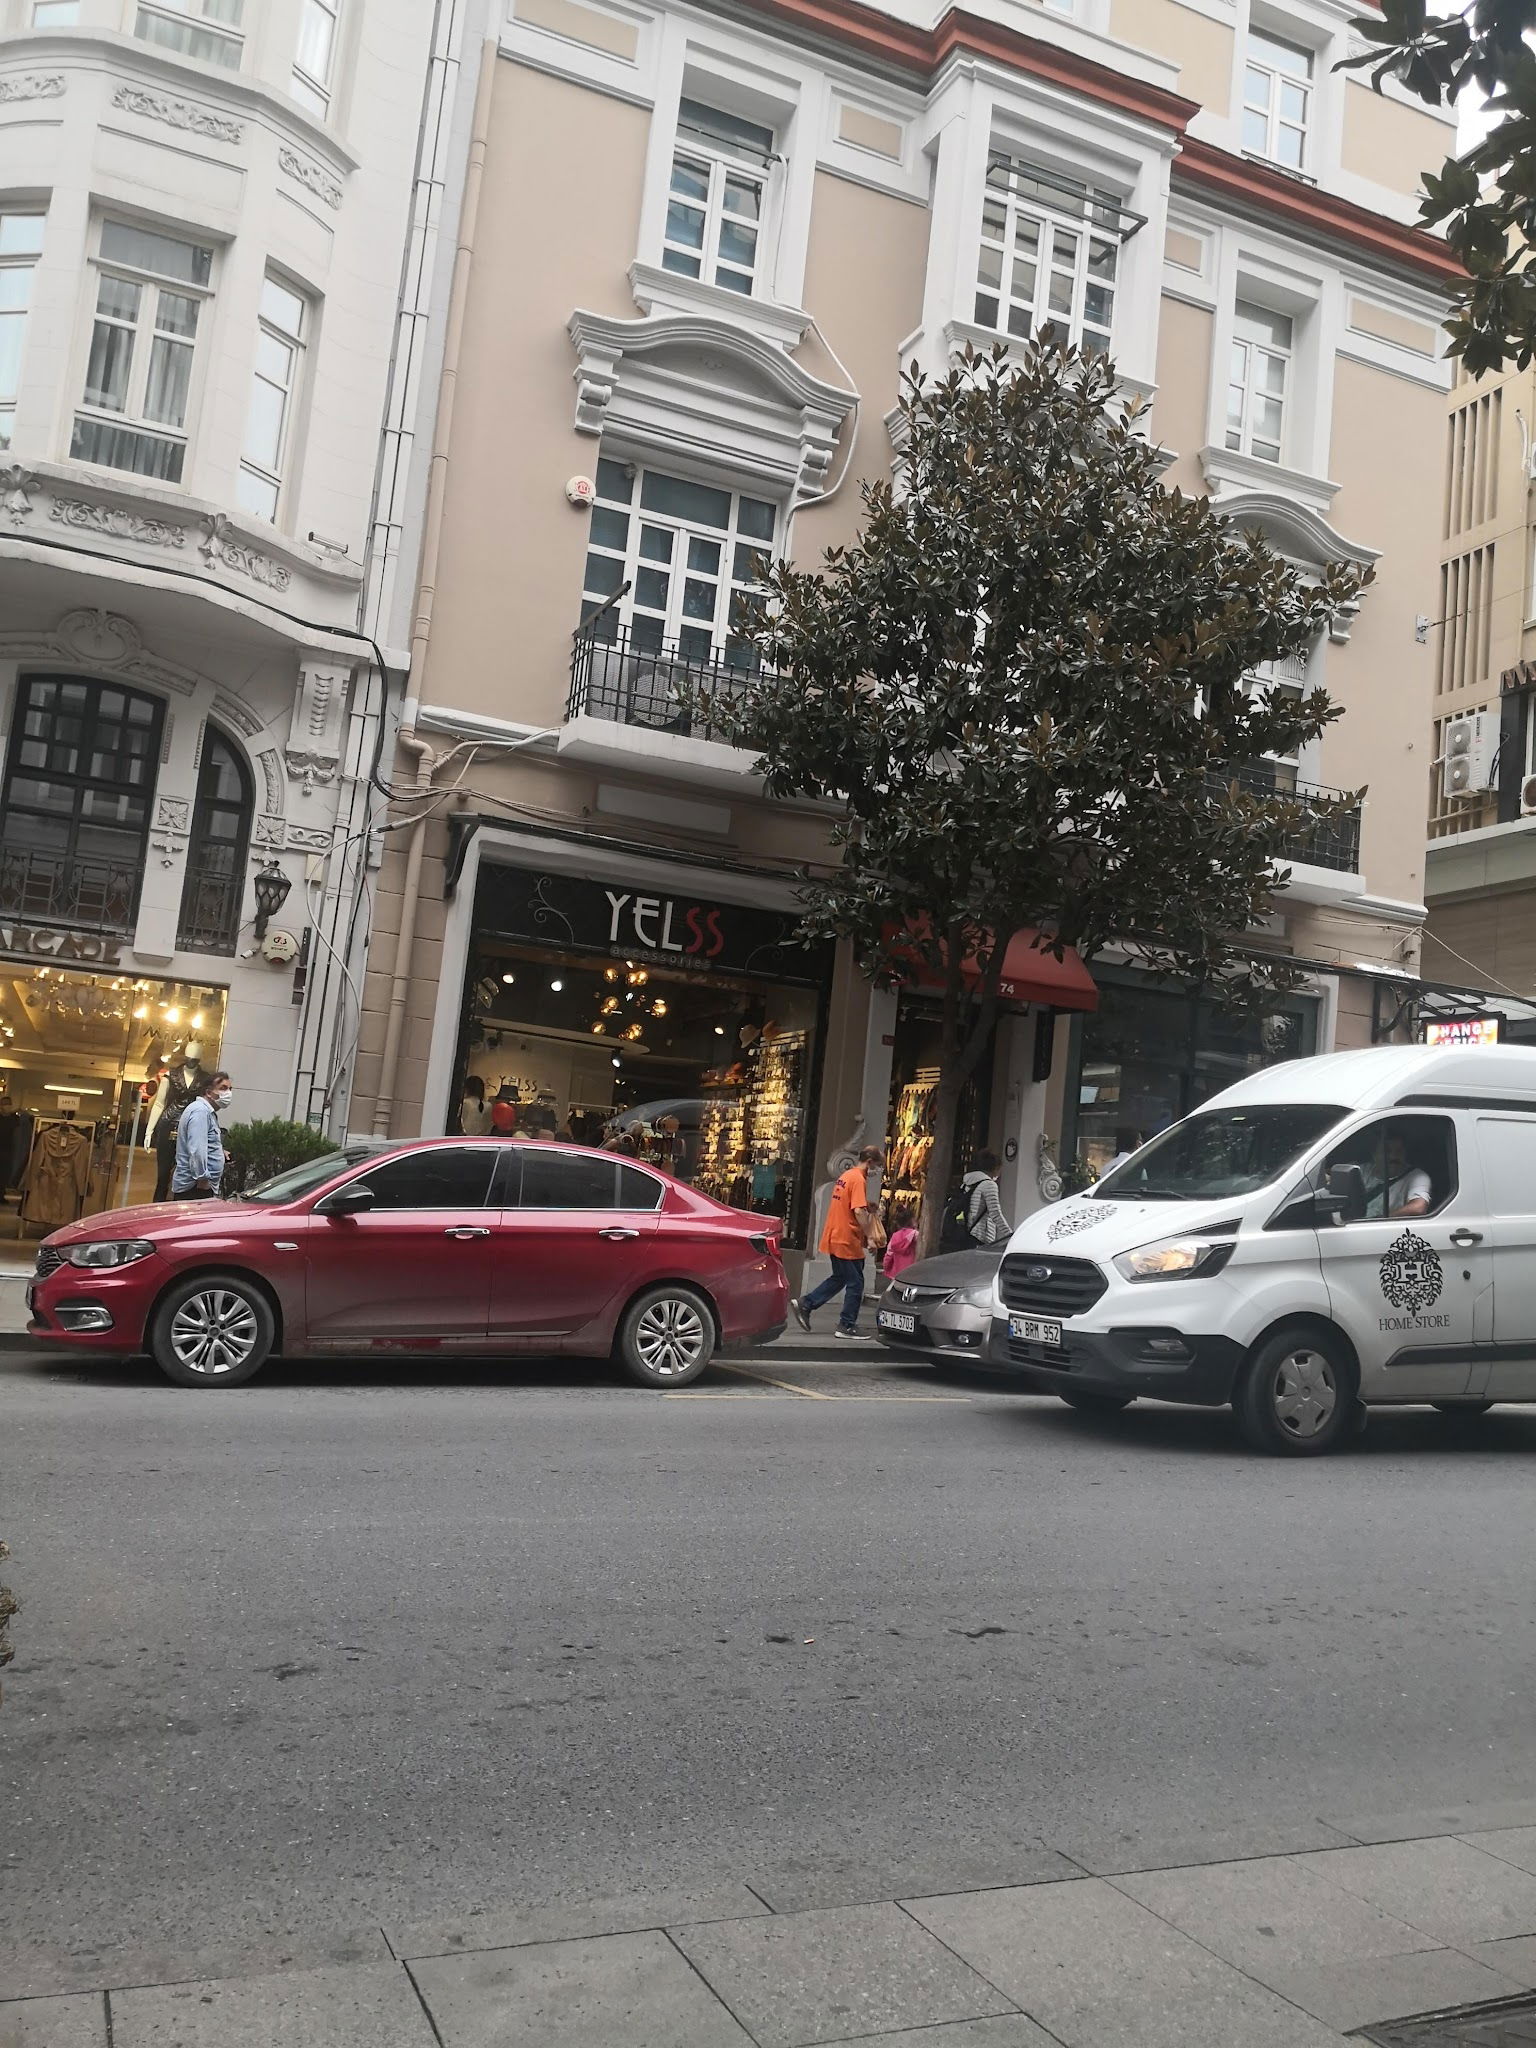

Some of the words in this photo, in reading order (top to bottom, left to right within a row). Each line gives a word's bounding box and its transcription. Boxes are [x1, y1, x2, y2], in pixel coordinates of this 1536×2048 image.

[605, 891, 724, 957] YELSS
[1430, 1022, 1492, 1038] HANGE
[1013, 1319, 1023, 1336] 34
[1025, 1322, 1039, 1339] BRM
[1043, 1325, 1059, 1342] 952
[1379, 1317, 1413, 1331] HOME
[1415, 1315, 1450, 1328] STORE
